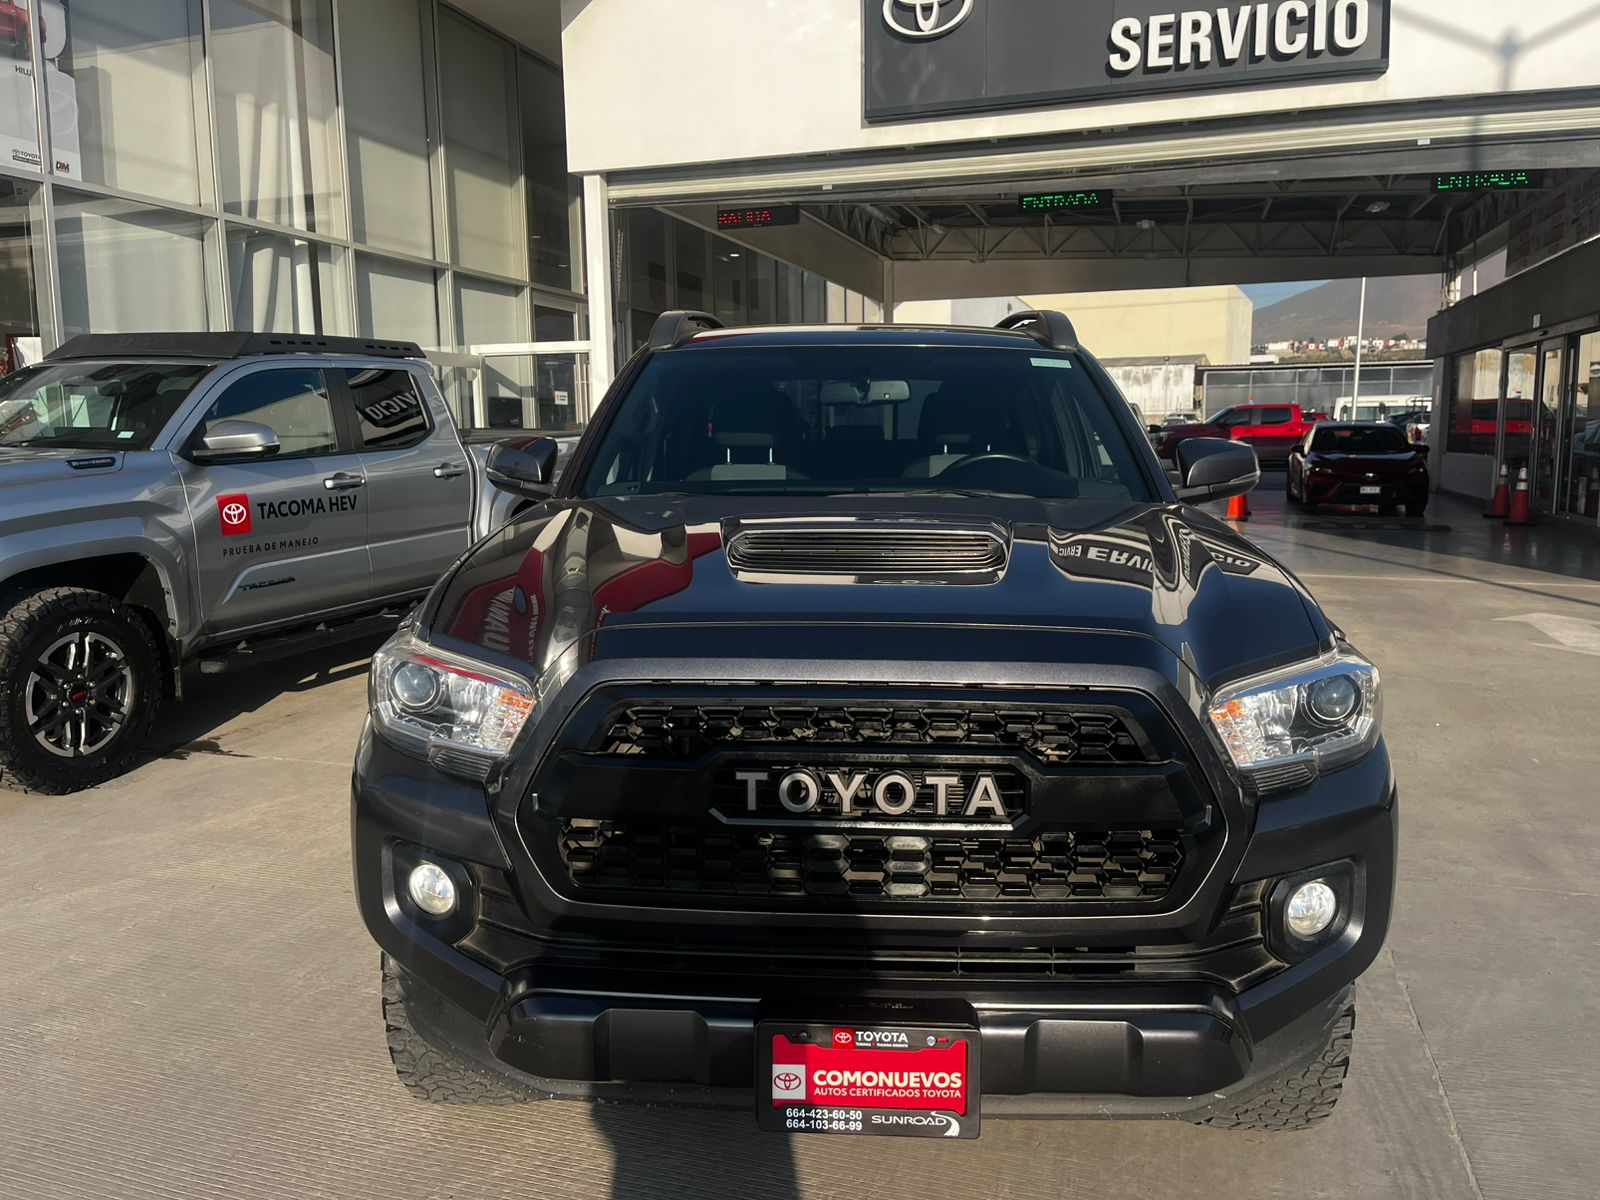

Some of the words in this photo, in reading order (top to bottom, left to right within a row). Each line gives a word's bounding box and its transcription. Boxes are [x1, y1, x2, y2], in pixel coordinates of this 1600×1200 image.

[1108, 0, 1369, 71] SERVICIO
[15, 65, 33, 77] HILU
[257, 498, 326, 519] TACOMA
[328, 495, 357, 513] HEV
[223, 544, 262, 557] PRUEBA
[264, 542, 277, 551] DE
[279, 536, 319, 549] MANEJO
[735, 769, 1006, 816] TOYOTA
[855, 1031, 909, 1043] TOYOTA
[813, 1069, 962, 1088] COMONUEVOS
[813, 1087, 847, 1097] AUTOS
[849, 1087, 921, 1098] CERTIFICADOS
[923, 1089, 962, 1099] TOYOTA
[786, 1108, 862, 1120] 664-423-60-50
[871, 1114, 948, 1126] SUNROAD
[786, 1119, 862, 1131] 664-103-66-99
